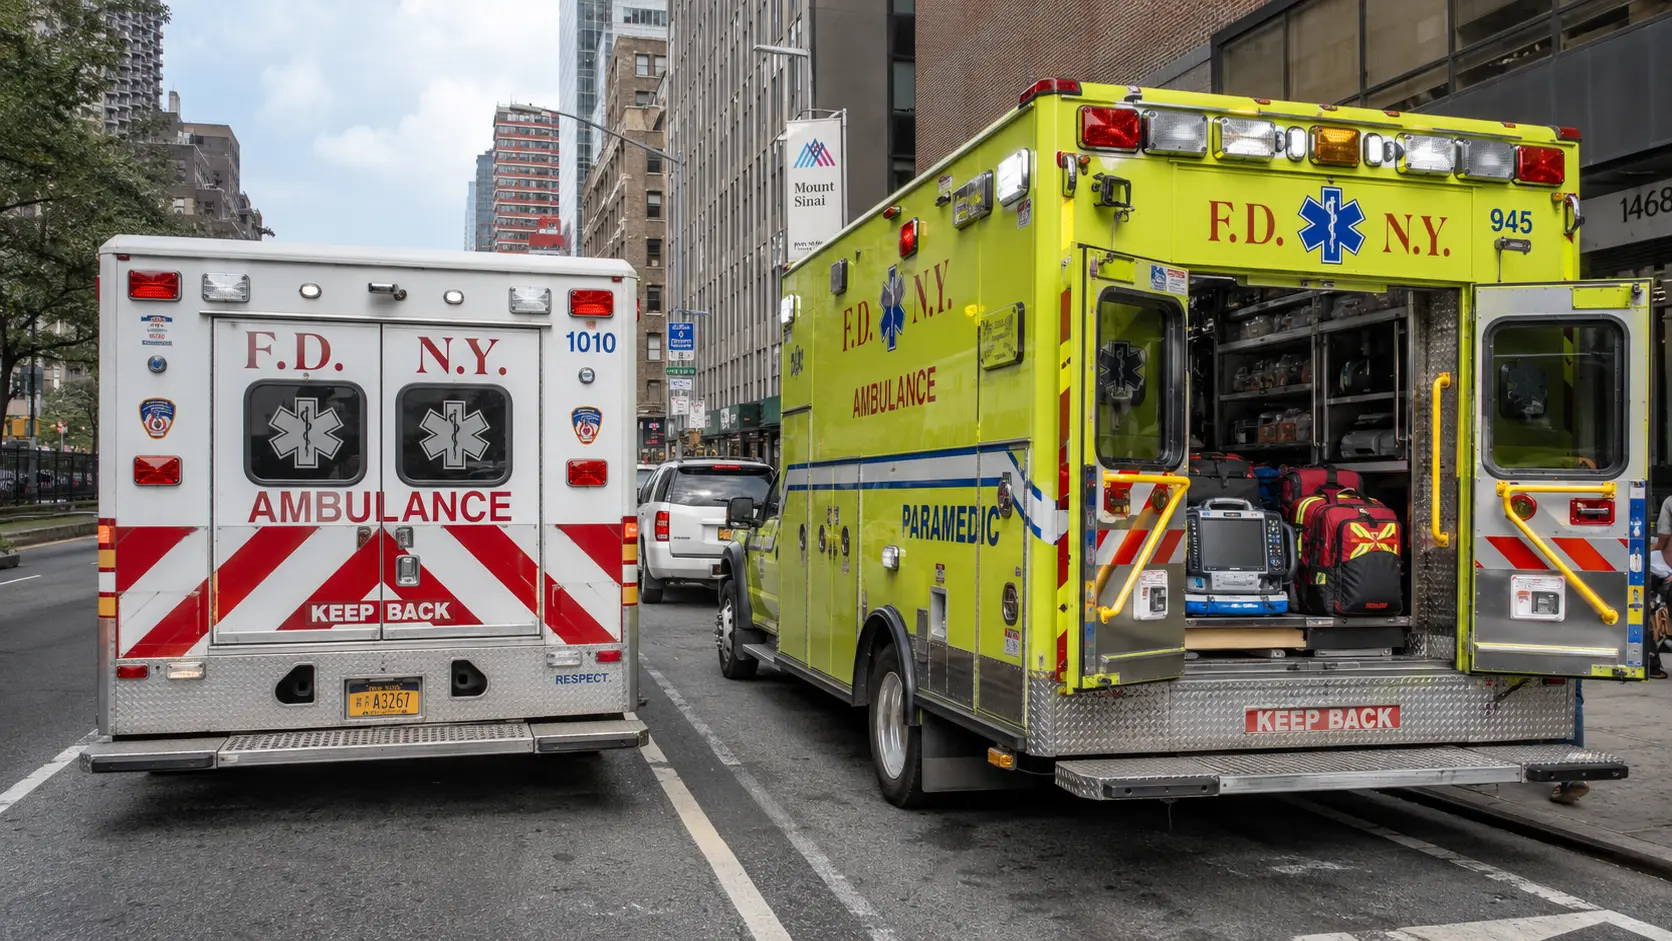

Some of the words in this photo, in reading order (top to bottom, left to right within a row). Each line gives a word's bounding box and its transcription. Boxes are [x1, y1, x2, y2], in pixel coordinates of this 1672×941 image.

[794, 182, 835, 194] Mount
[794, 195, 826, 207] Sinai
[1620, 186, 1672, 223] 1468
[1209, 201, 1283, 247] F.D.
[1383, 213, 1450, 257] N.Y.
[1490, 208, 1533, 234] 945
[842, 300, 873, 352] F.D.
[912, 258, 953, 324] N.Y.
[246, 331, 344, 371] F.D.
[417, 336, 508, 375] N.Y.
[566, 331, 617, 353] 1010
[852, 366, 937, 418] AMBULANCE
[248, 490, 512, 523] AMBULANCE
[902, 504, 1001, 546] PARAMEDIC
[311, 603, 374, 624] KEEP
[387, 600, 451, 621] BACK
[555, 672, 612, 685] RESPECT.
[372, 692, 410, 709] A3267
[1256, 709, 1320, 732] KEEP
[1328, 707, 1392, 730] BACK
